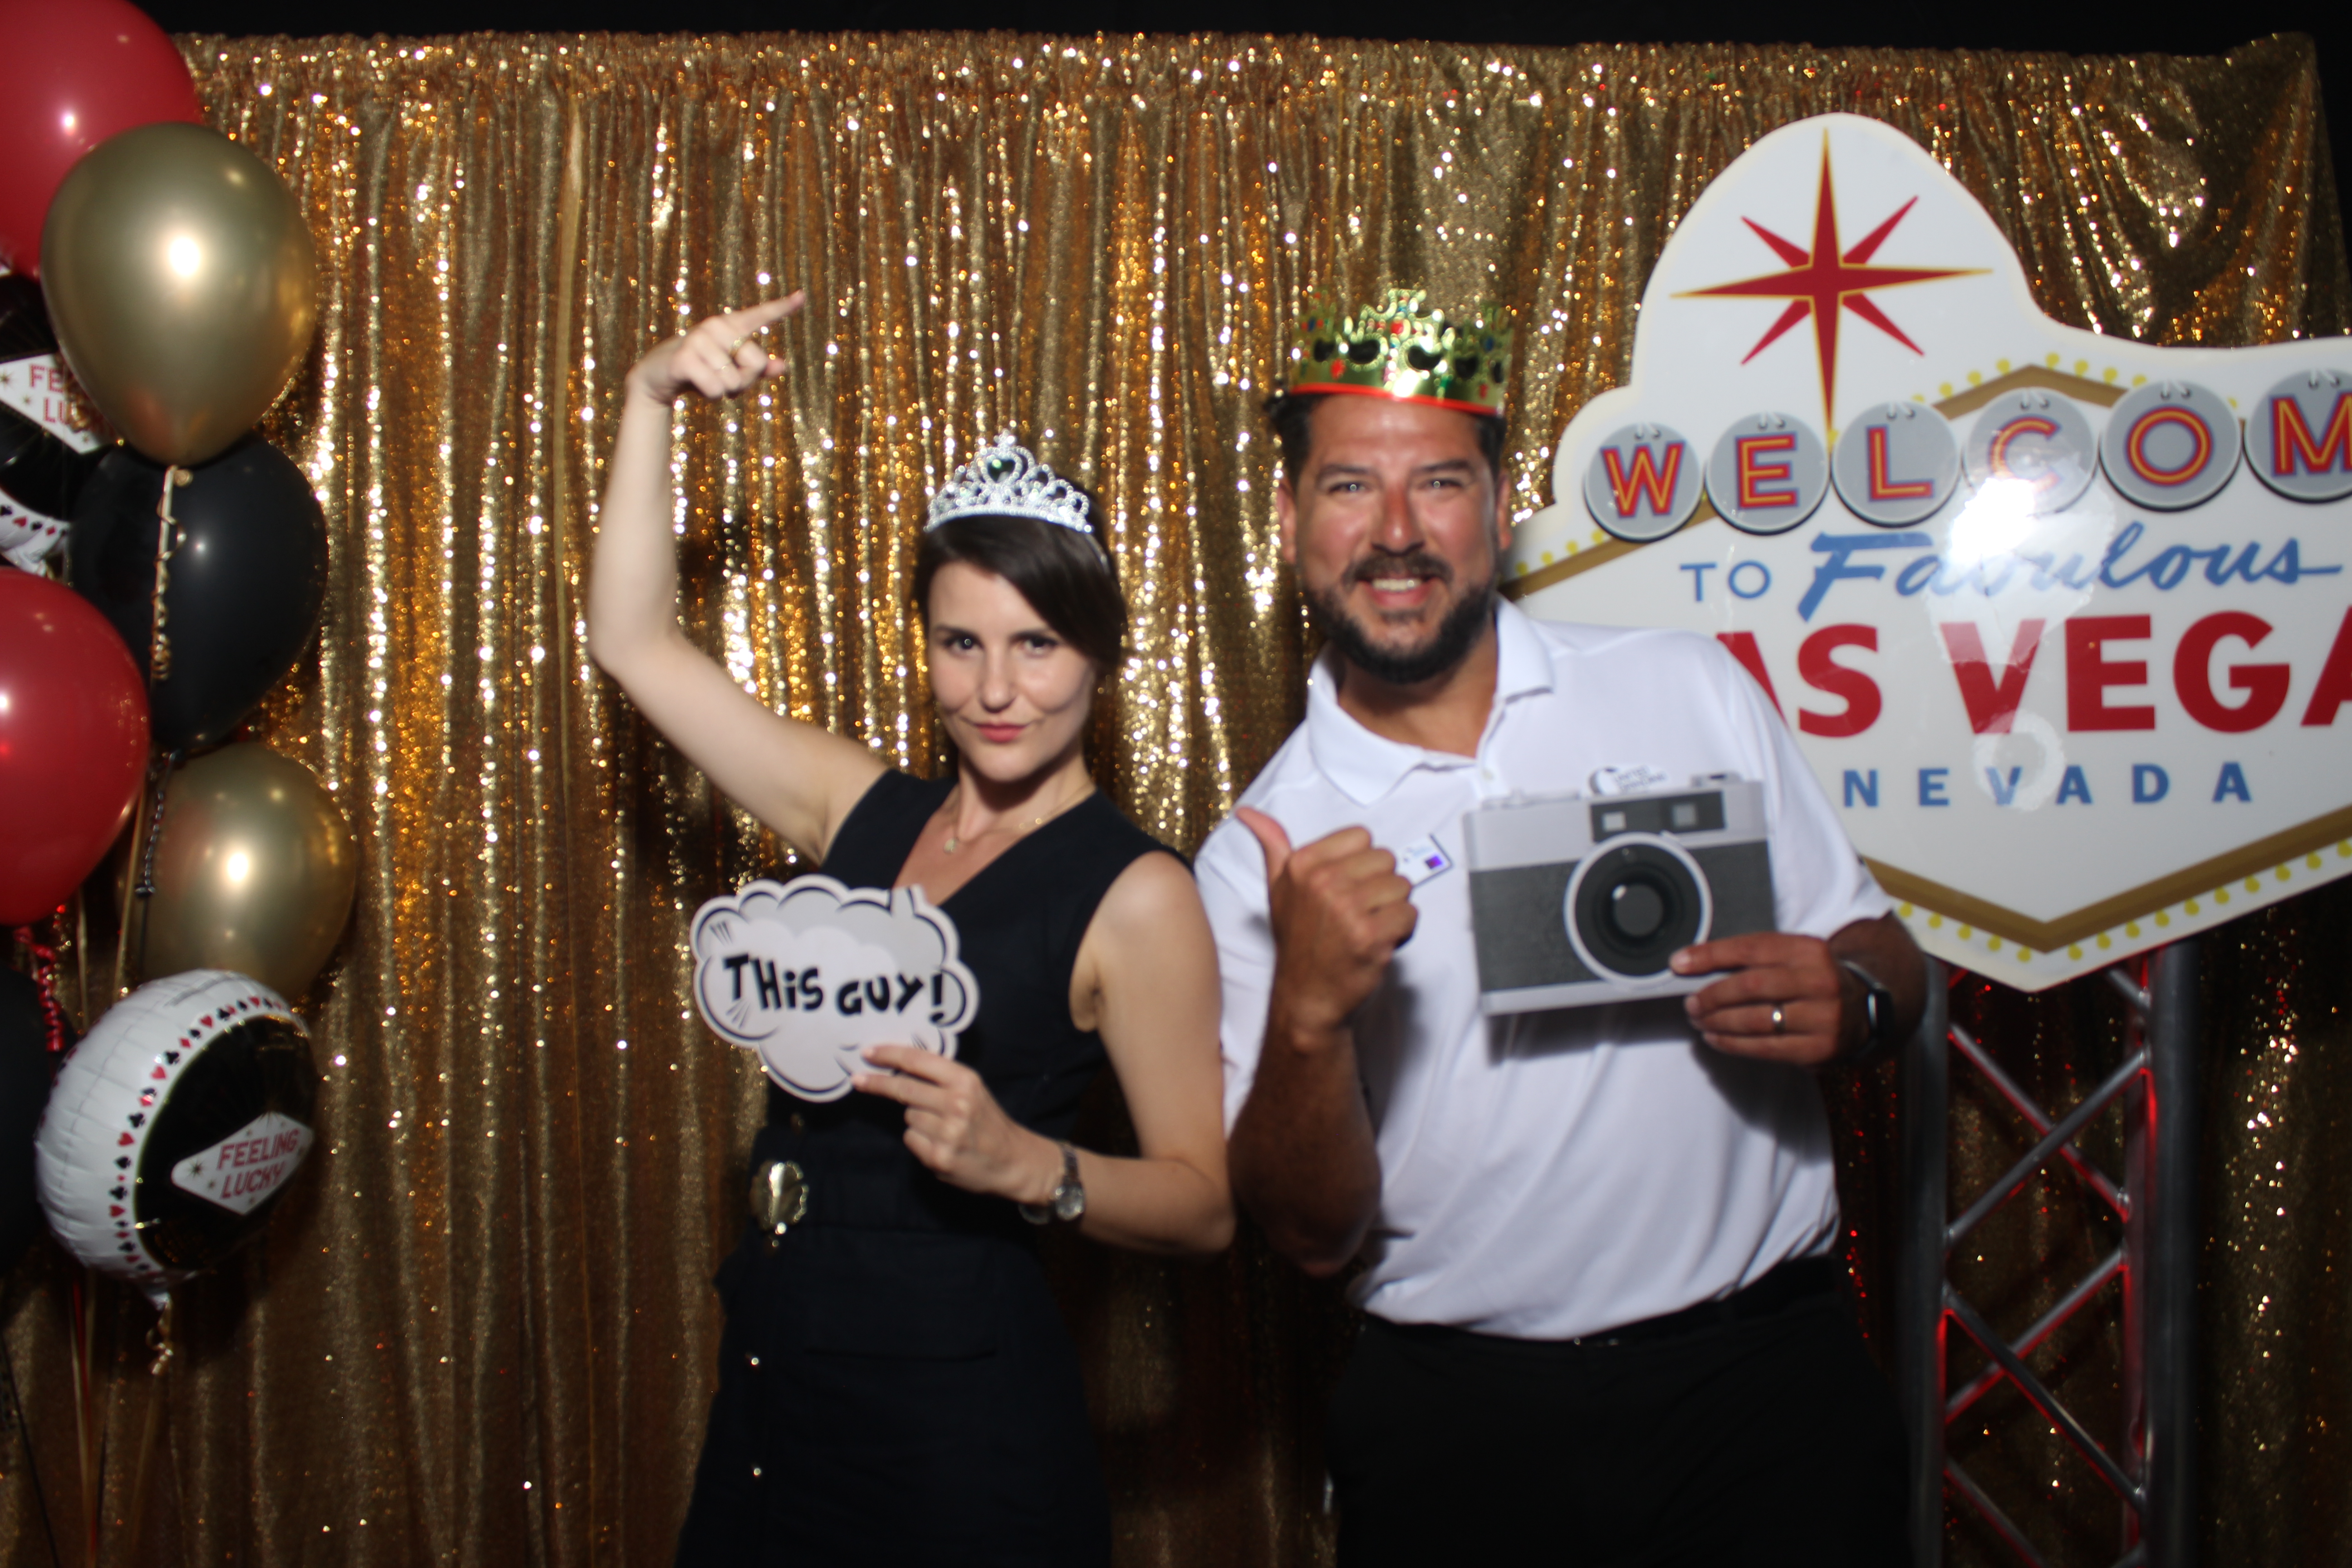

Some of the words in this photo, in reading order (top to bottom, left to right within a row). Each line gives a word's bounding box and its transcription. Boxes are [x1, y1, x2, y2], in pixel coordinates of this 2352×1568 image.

[1680, 559, 1771, 603] TO
[1842, 762, 2253, 808] NEVADA
[836, 973, 944, 1024] GUY!
[217, 1129, 299, 1171] FEELING
[220, 1161, 286, 1200] LUCKY
